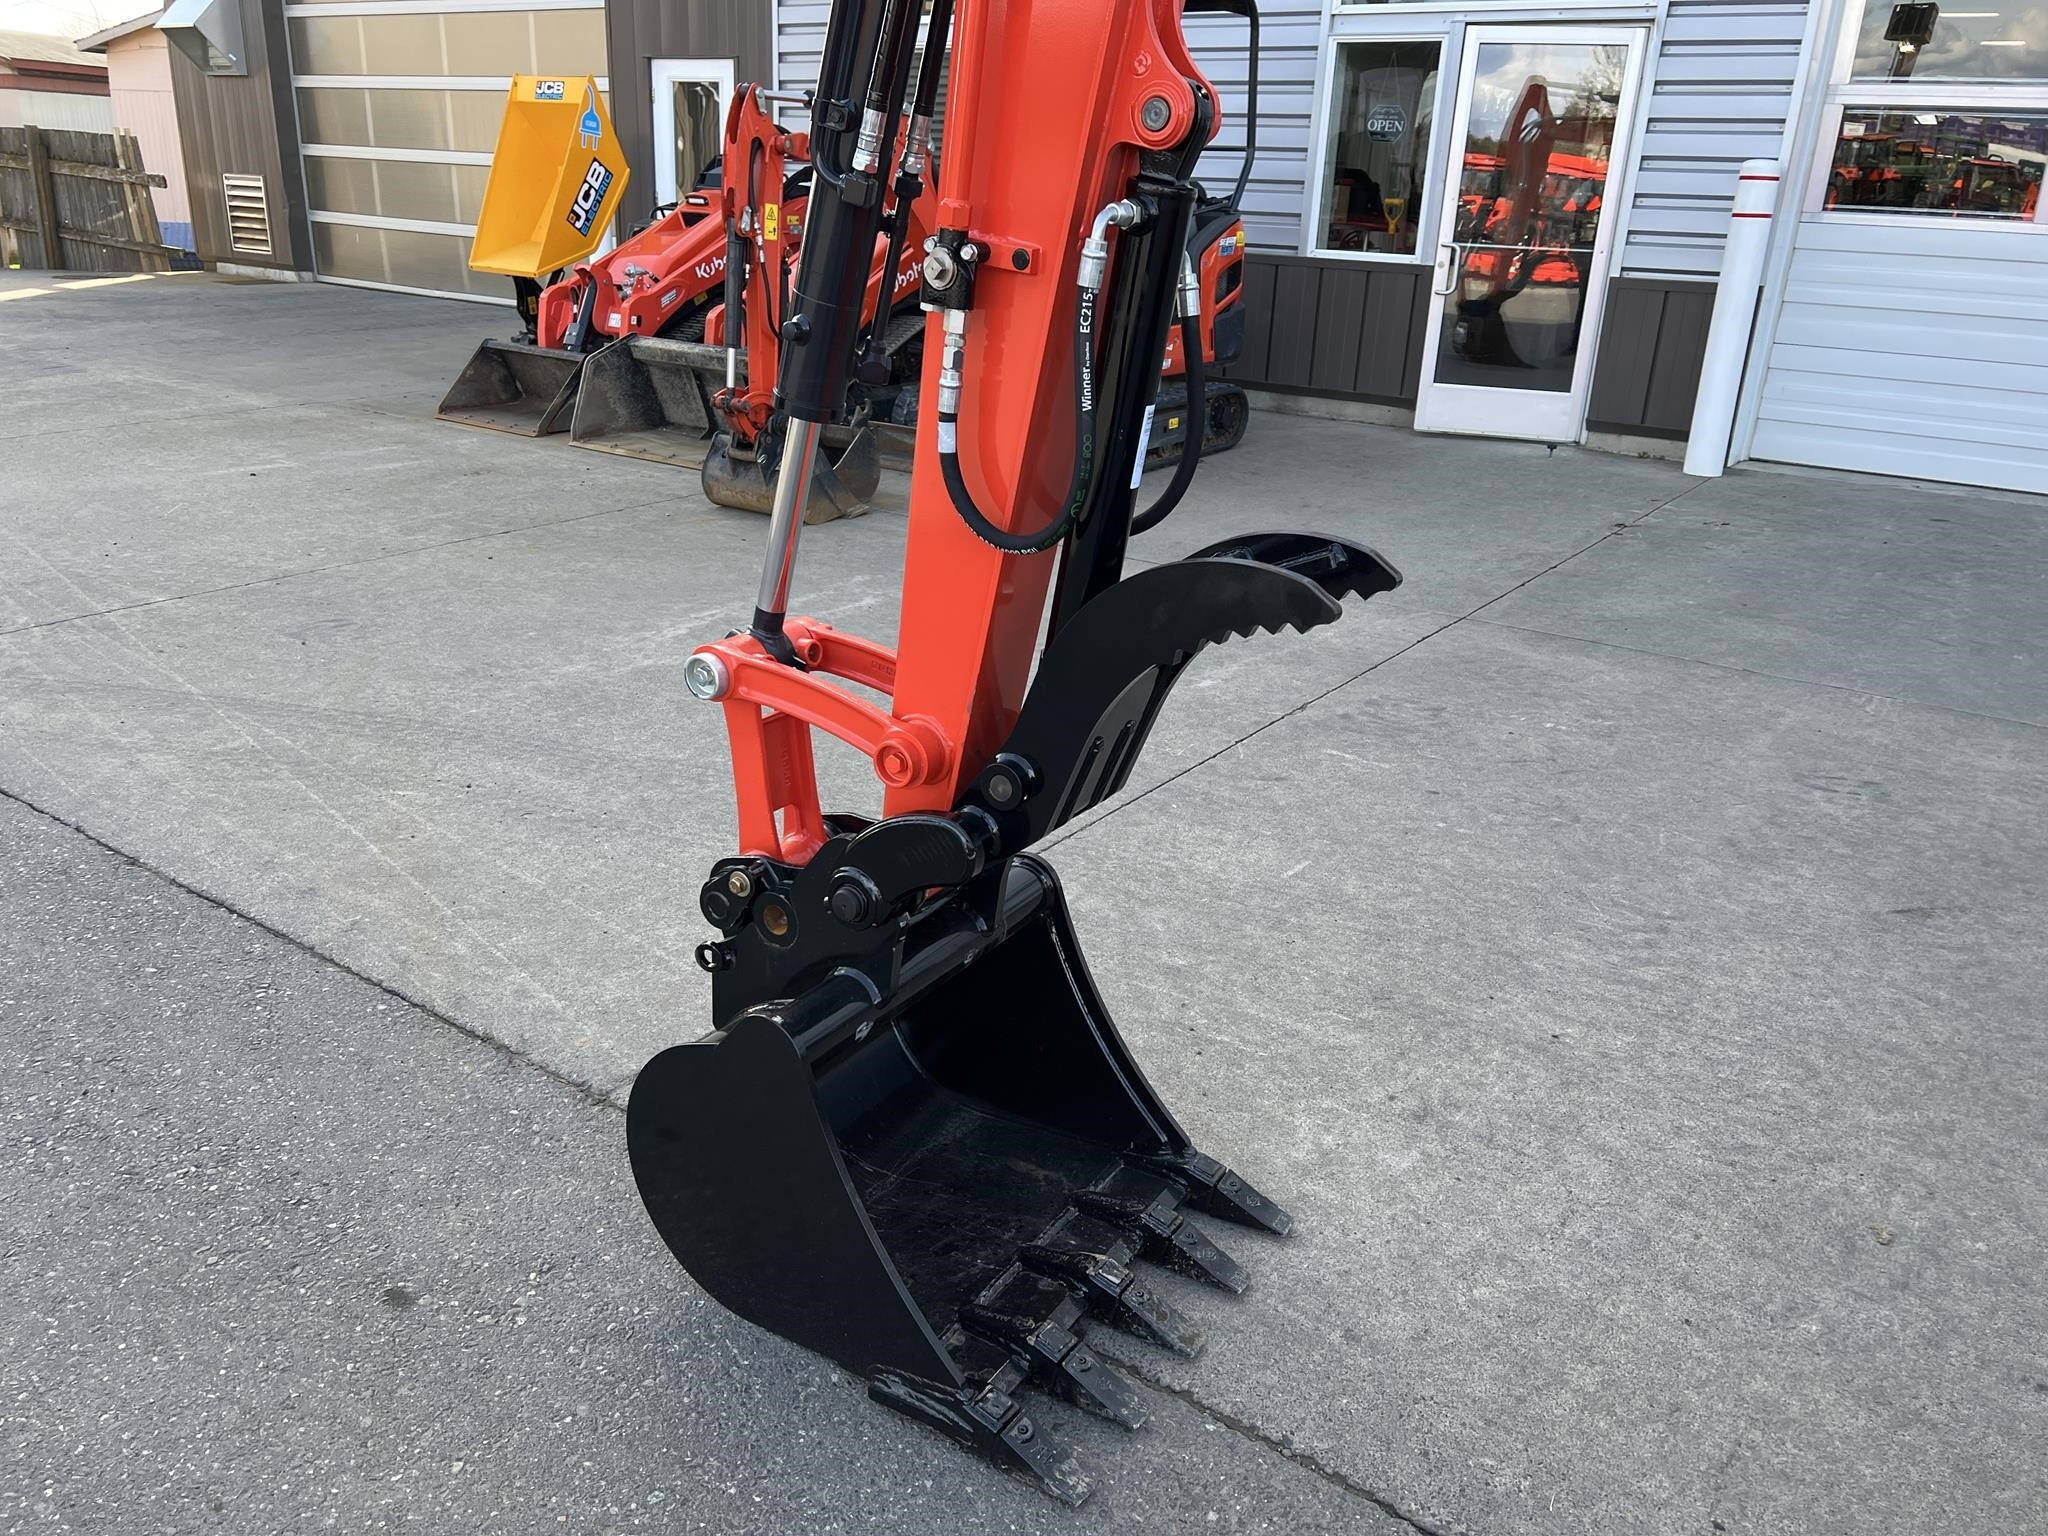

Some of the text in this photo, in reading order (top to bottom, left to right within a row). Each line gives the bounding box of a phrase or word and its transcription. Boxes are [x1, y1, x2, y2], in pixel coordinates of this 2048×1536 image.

[536, 81, 564, 94] JCB
[1367, 119, 1404, 131] OPEN
[574, 161, 606, 229] JCB
[580, 172, 611, 236] ELECTRIC
[1081, 367, 1093, 411] Winner
